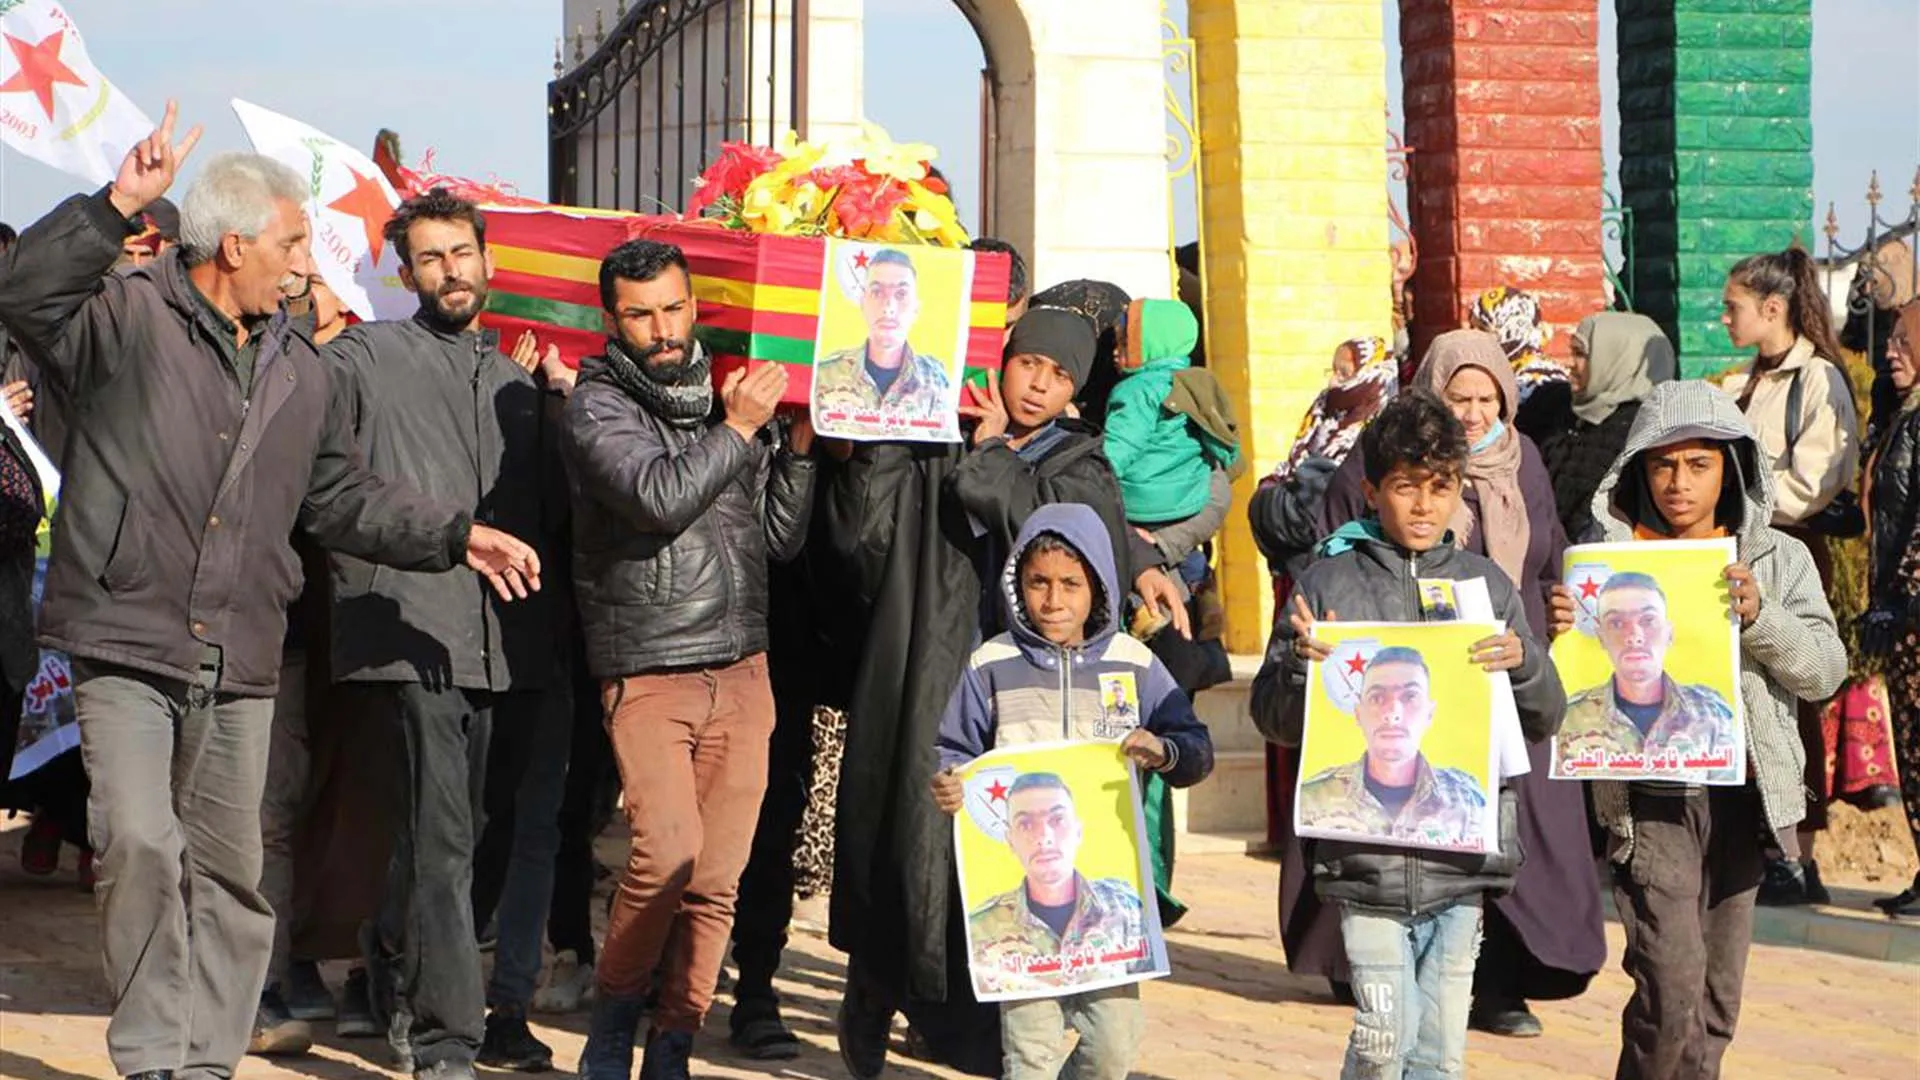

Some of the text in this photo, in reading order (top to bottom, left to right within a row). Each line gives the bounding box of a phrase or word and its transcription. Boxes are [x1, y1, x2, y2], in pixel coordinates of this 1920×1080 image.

[1608, 751, 1644, 768] محمد
[1684, 747, 1733, 768] الشهيد
[1100, 938, 1148, 963] الشهيد
[1027, 957, 1062, 974] محمد
